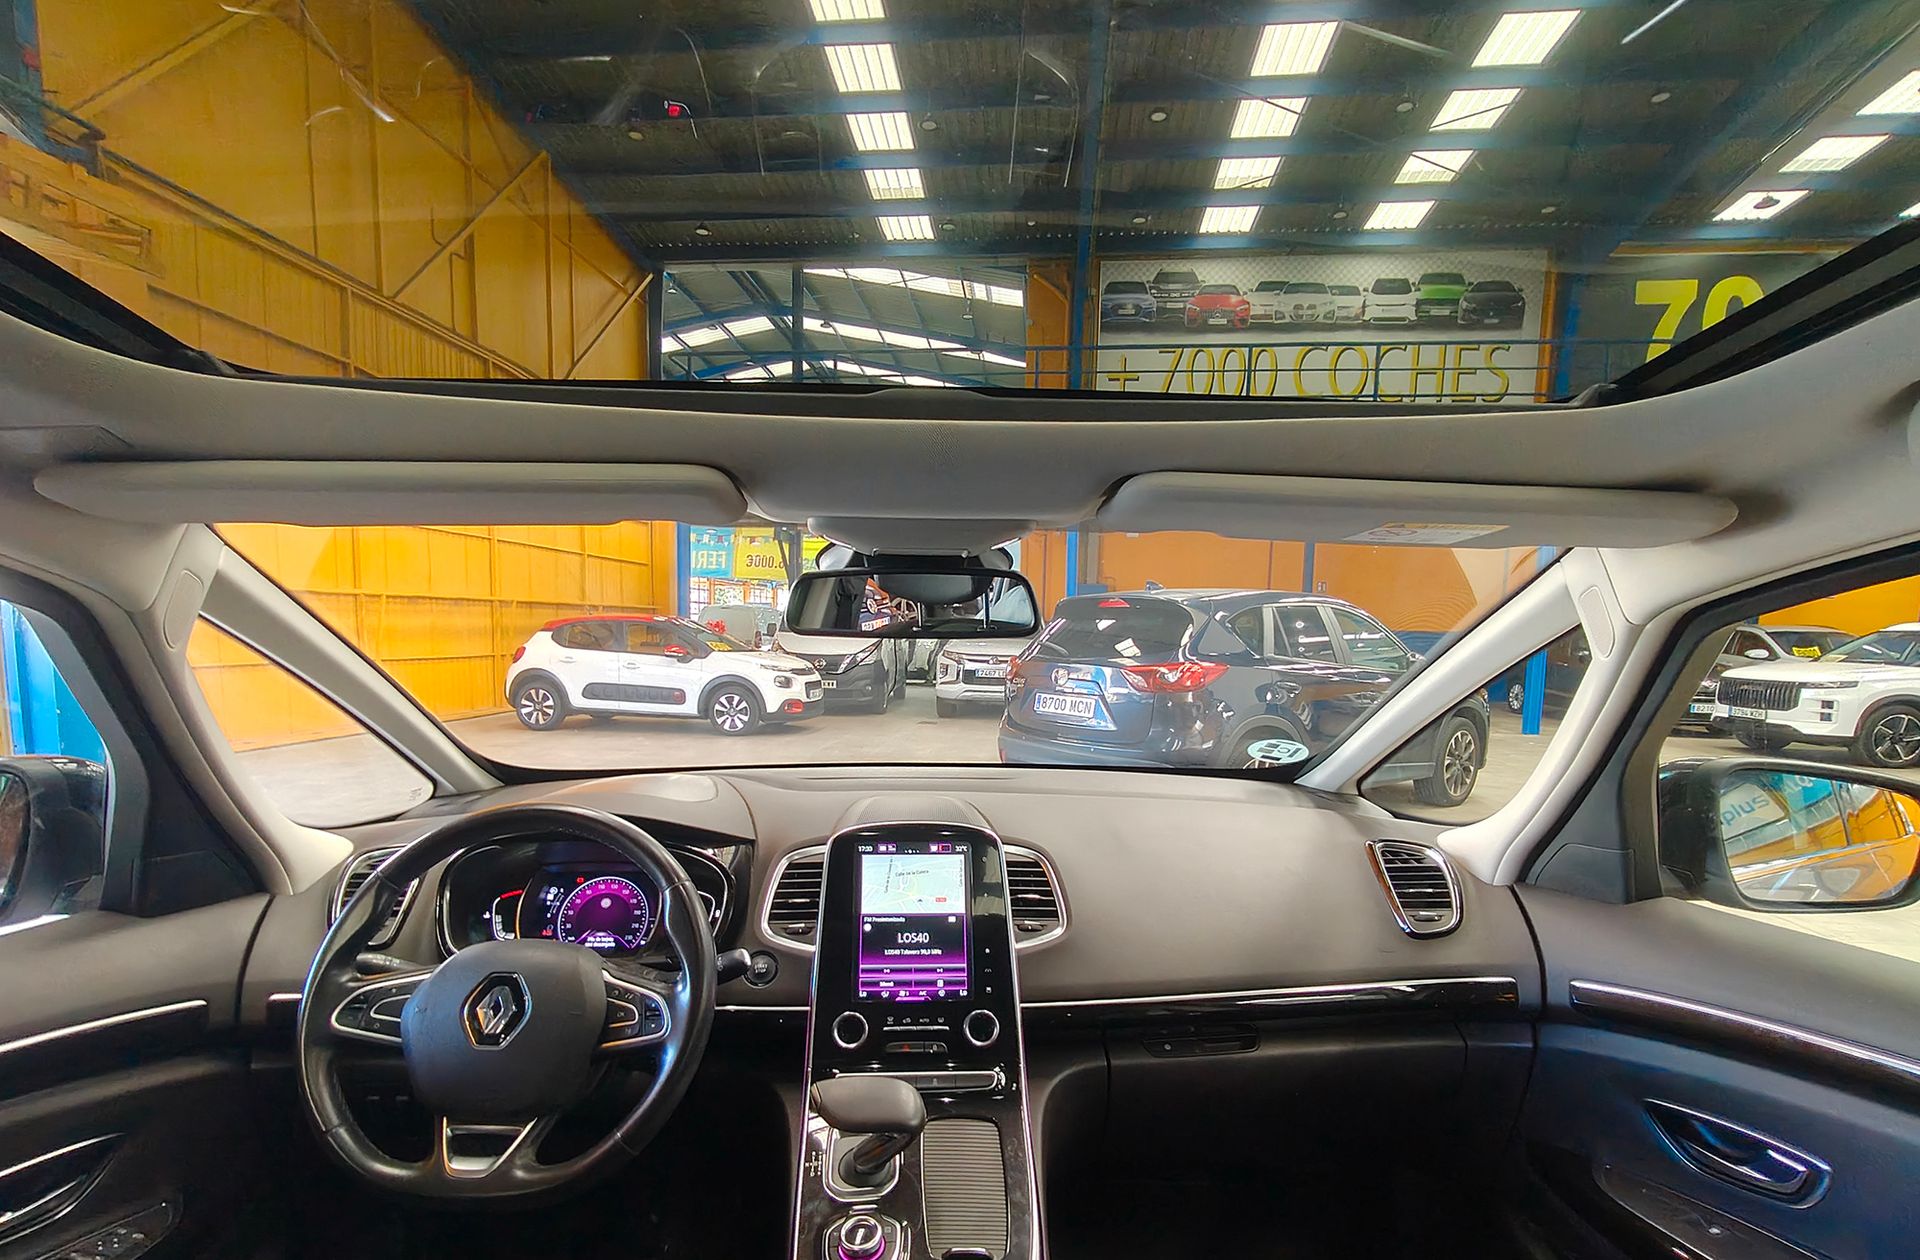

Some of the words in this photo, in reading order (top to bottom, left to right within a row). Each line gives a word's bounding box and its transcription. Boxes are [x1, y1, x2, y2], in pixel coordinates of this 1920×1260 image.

[1158, 346, 1279, 396] 7000
[1293, 344, 1511, 403] COCHES
[1041, 696, 1066, 711] 8700
[1068, 699, 1092, 715] MCN
[1722, 795, 1769, 826] plus
[897, 932, 930, 943] LOS40
